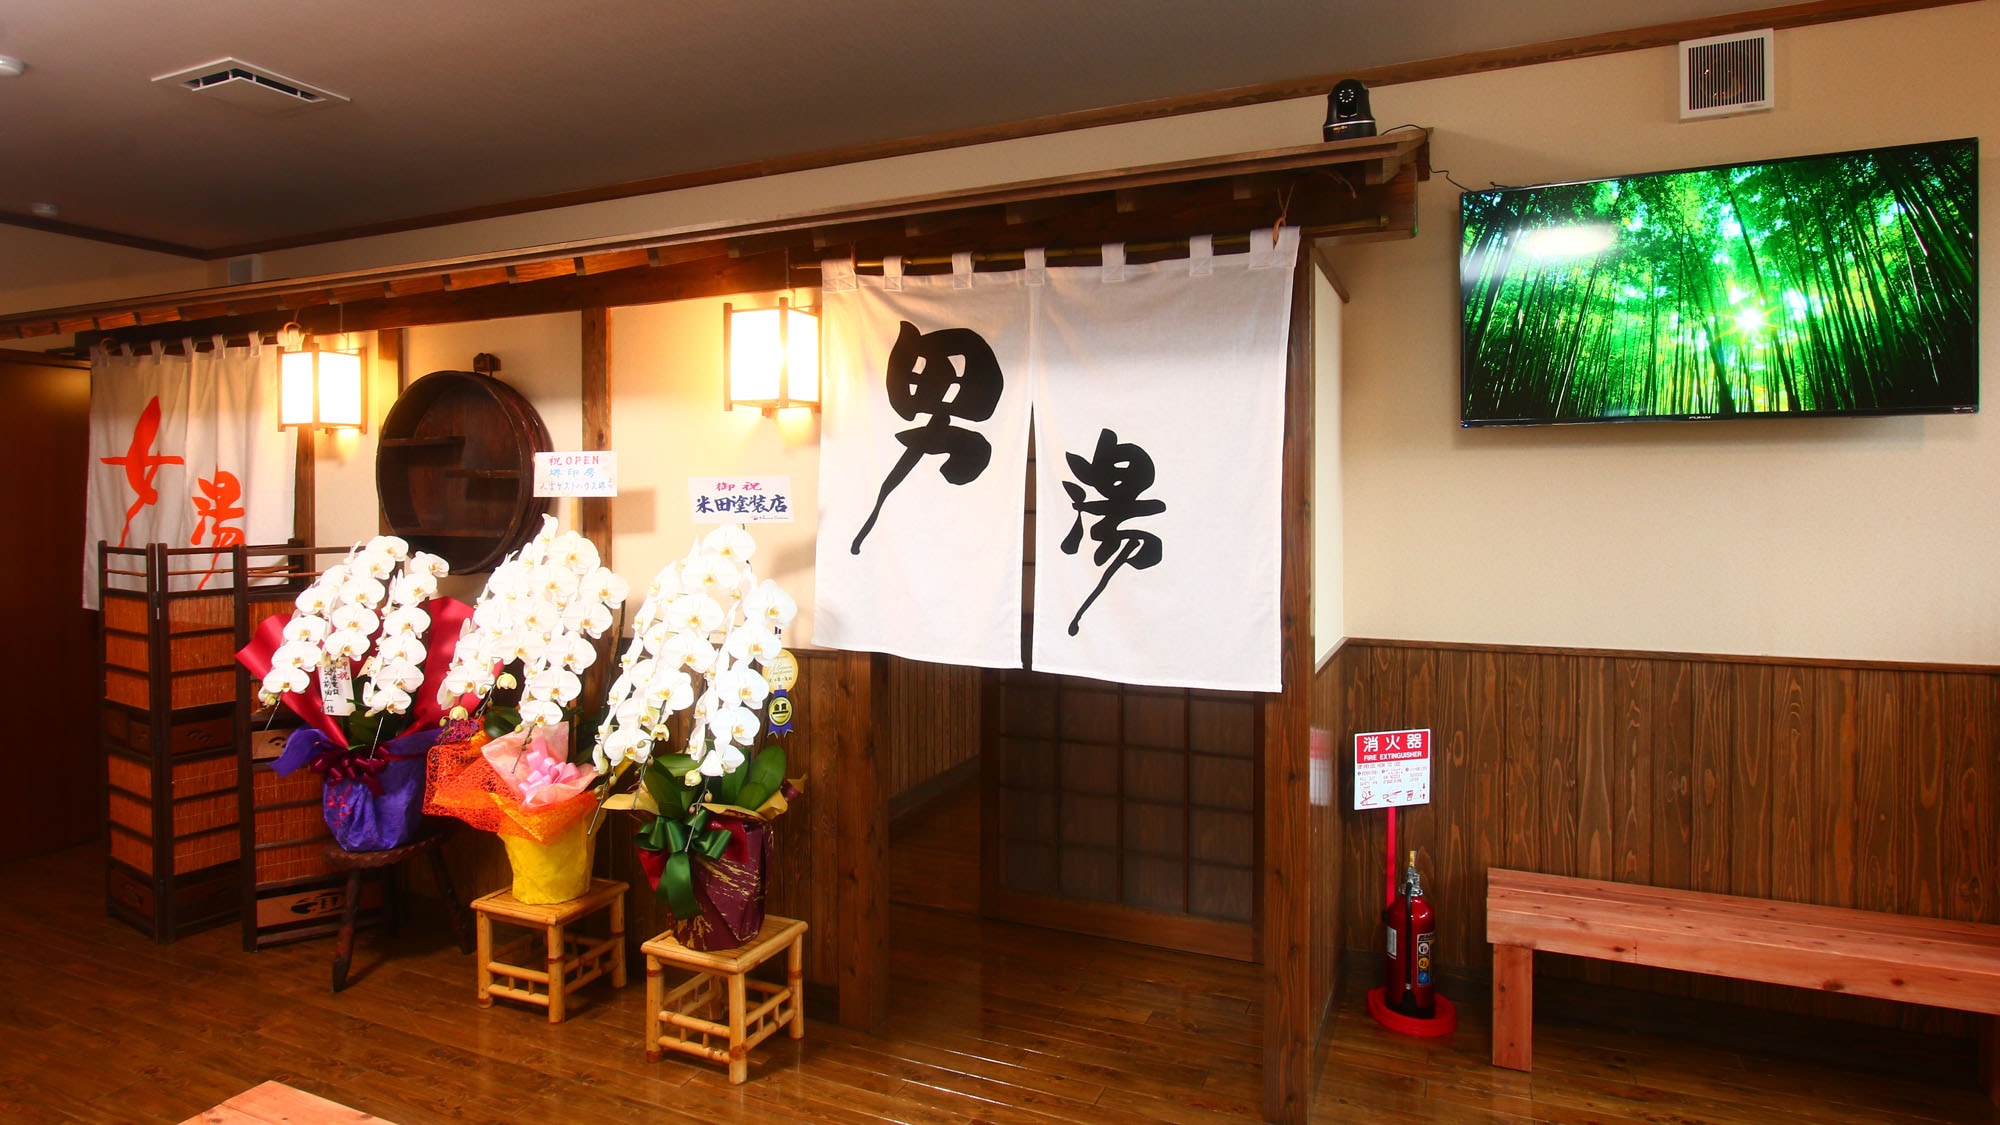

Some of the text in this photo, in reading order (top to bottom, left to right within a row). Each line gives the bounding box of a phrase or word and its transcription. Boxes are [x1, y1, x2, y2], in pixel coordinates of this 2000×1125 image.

[548, 455, 599, 466] 祝 OPEN
[715, 481, 763, 491] 御祝
[850, 320, 1167, 637] 男湯
[100, 395, 246, 590] 女湯
[695, 494, 788, 514] 米田塗装店
[1363, 733, 1422, 753] 消火器
[1379, 751, 1422, 760] EXTINGUISHER
